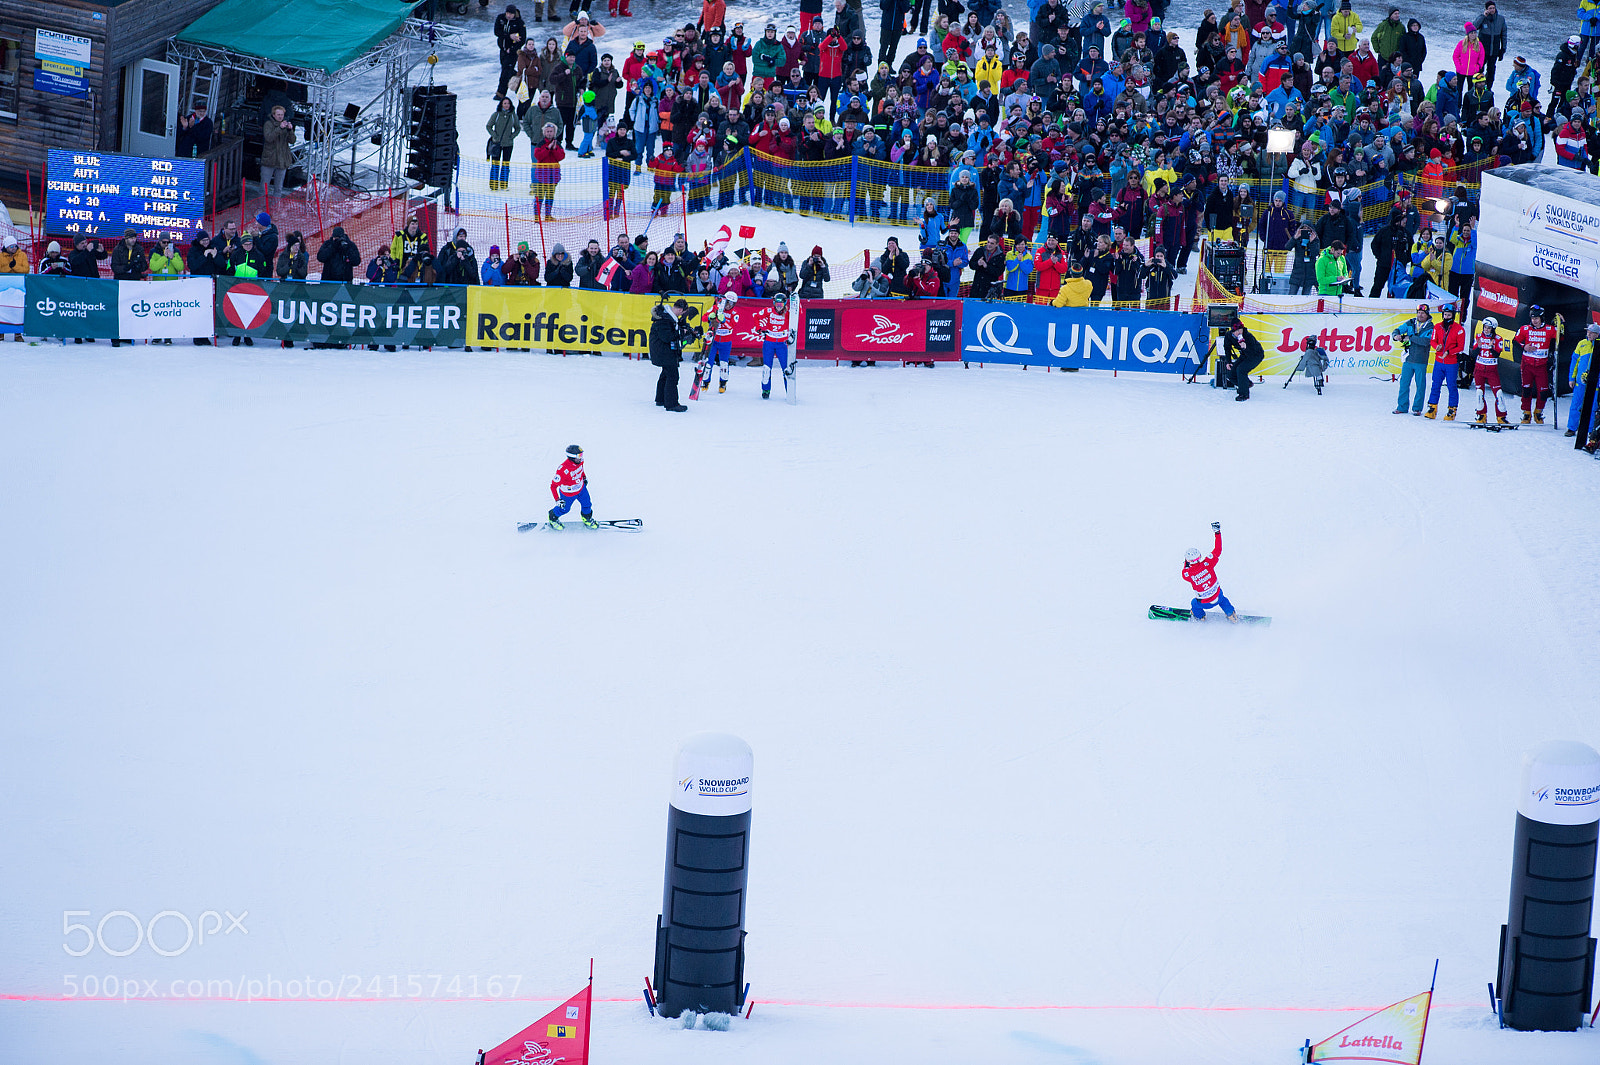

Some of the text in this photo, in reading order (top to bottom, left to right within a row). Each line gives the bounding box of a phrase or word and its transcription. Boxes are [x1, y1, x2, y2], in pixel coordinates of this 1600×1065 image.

[74, 155, 100, 166] BLUE
[73, 168, 99, 179] AUT1
[59, 209, 110, 222] PAYER A.
[124, 213, 190, 228] PROMMEGGER
[1546, 204, 1600, 228] SNOWBOARD
[1546, 215, 1584, 233] WORLD CUP
[1535, 245, 1580, 266] Lackenhof am
[1532, 254, 1579, 278] ÖTSCHER
[36, 297, 56, 311] cb
[59, 301, 106, 311] cashback
[131, 300, 151, 312] cb
[154, 299, 200, 309] cashback
[59, 309, 87, 318] world
[154, 308, 182, 317] world
[277, 300, 461, 330] UNSER HEER
[477, 312, 648, 348] Raiffeisen
[856, 333, 914, 344] moser
[1047, 322, 1201, 365] UNIQA
[1358, 357, 1390, 367] molke
[699, 777, 750, 786] SNOWBOARD
[1339, 1035, 1403, 1050] Lattella
